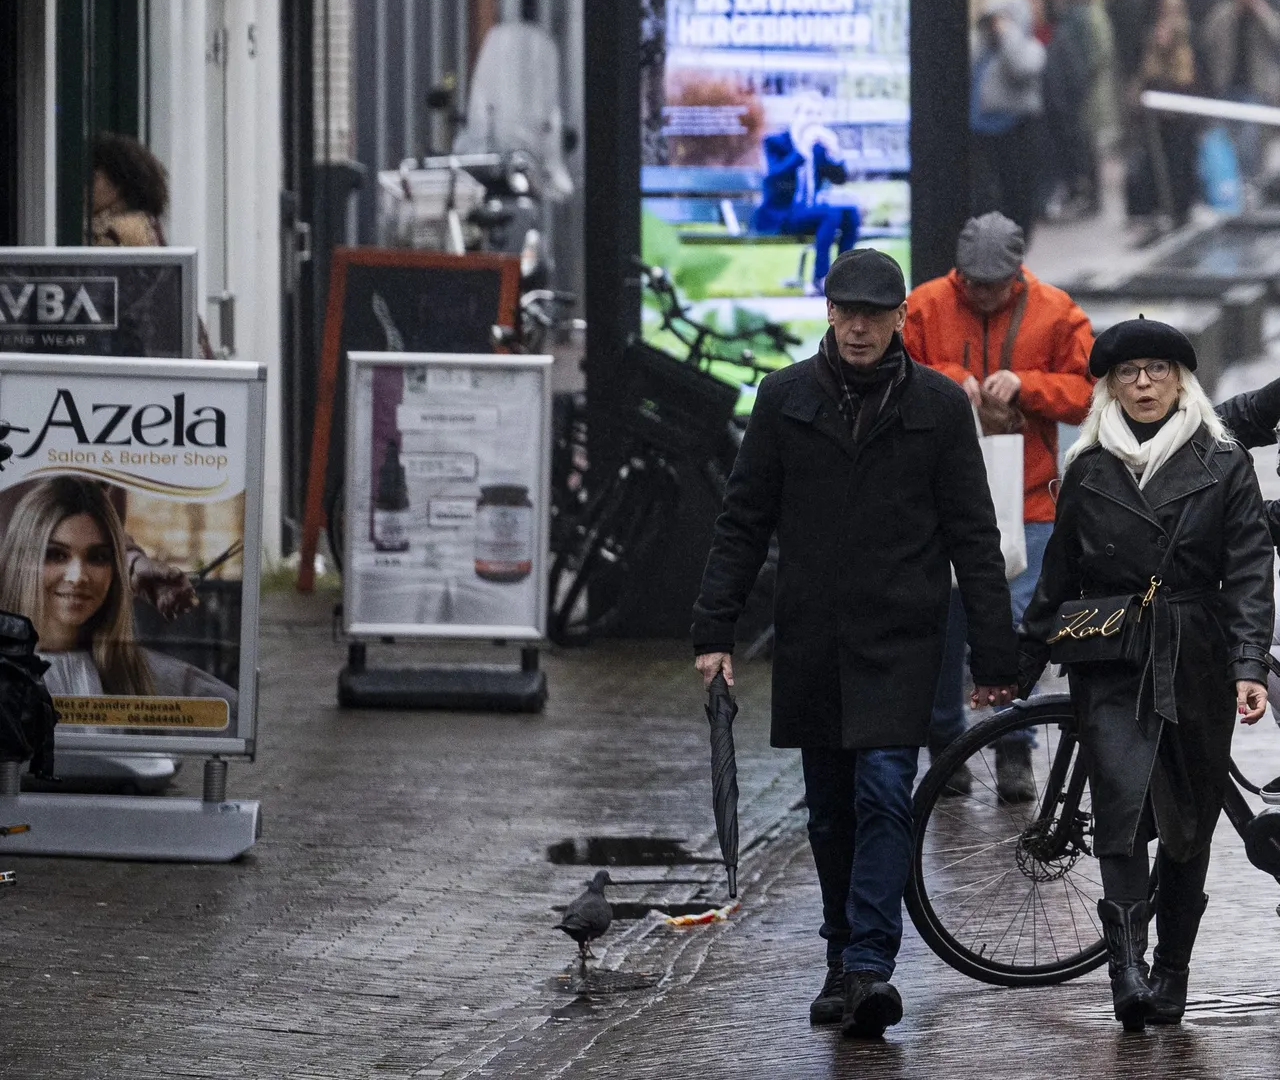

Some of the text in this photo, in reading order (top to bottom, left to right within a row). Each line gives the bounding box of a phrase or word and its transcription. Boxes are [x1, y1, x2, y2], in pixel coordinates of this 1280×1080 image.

[0, 284, 102, 323] VBA
[41, 333, 87, 347] WEAR
[15, 387, 227, 460] Azela
[47, 448, 228, 470] Salon & Barber Shop
[1046, 608, 1125, 644] Karl
